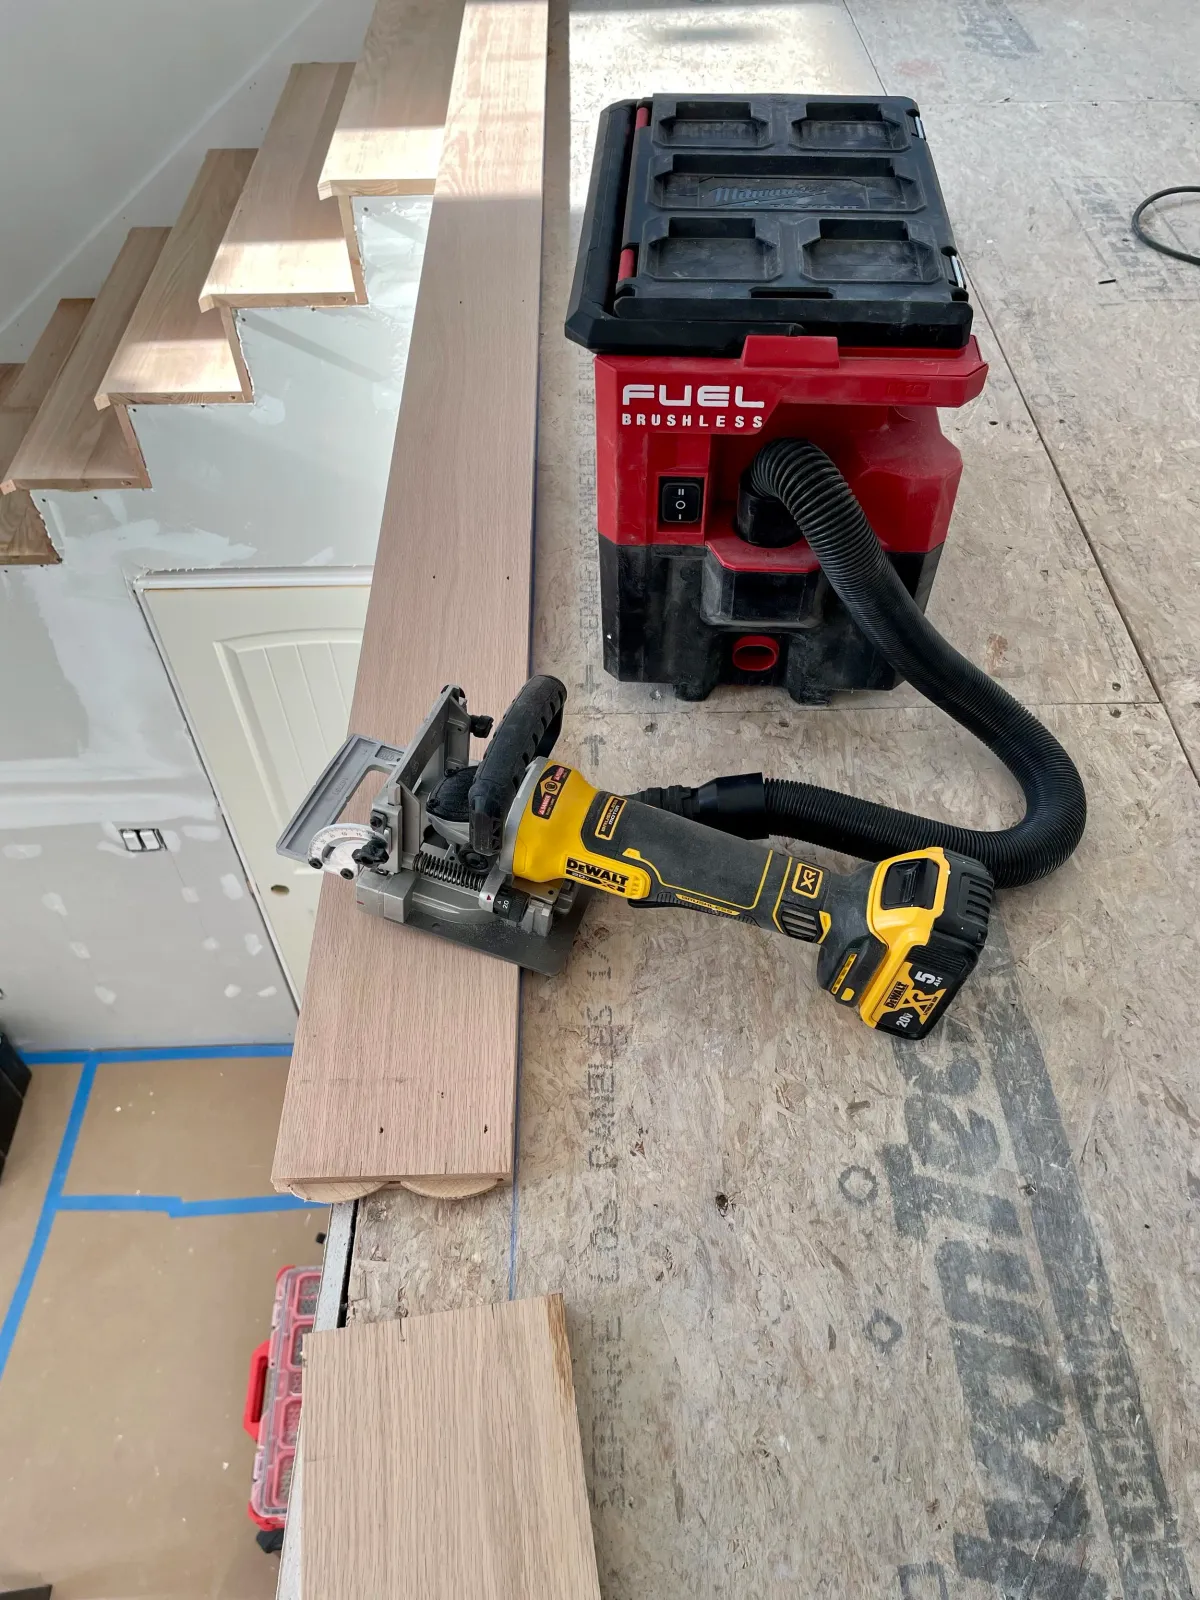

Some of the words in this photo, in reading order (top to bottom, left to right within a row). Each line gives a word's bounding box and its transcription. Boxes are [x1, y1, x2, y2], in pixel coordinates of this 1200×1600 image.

[622, 384, 765, 409] FUEL
[621, 413, 763, 428] BRUSHLESS
[799, 869, 817, 890] XR
[502, 899, 510, 909] 20
[914, 970, 936, 985] 5
